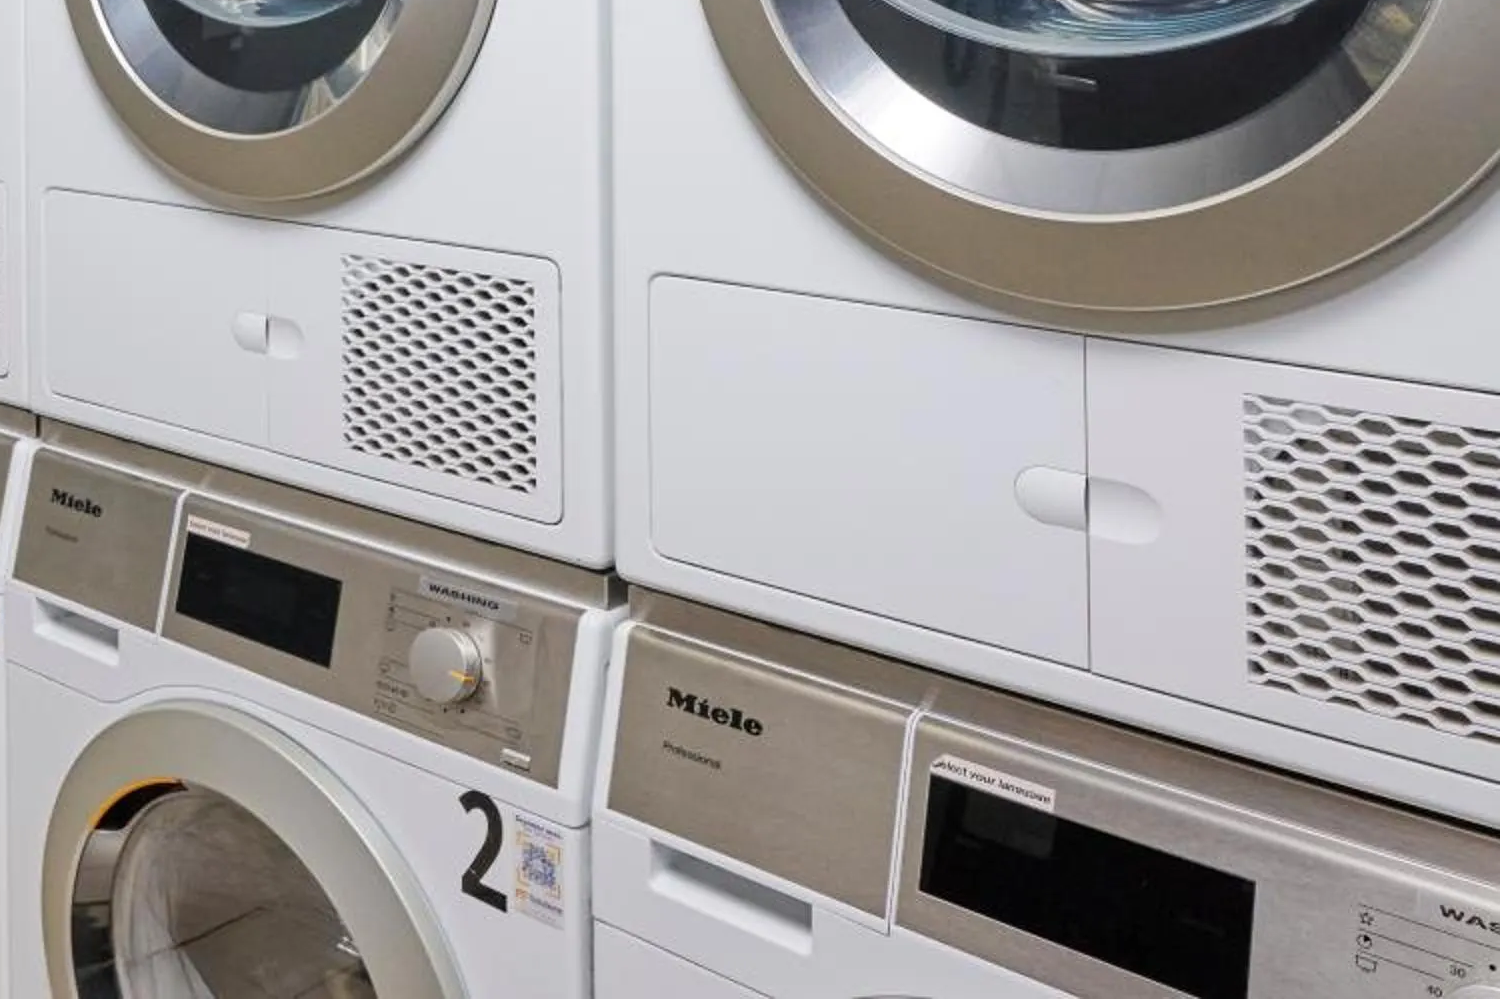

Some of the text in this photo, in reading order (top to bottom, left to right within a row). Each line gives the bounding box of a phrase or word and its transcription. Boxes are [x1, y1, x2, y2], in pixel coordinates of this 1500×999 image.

[51, 488, 104, 518] Miele
[428, 584, 499, 610] WASHING
[667, 686, 763, 736] Miele
[459, 790, 508, 913] 2
